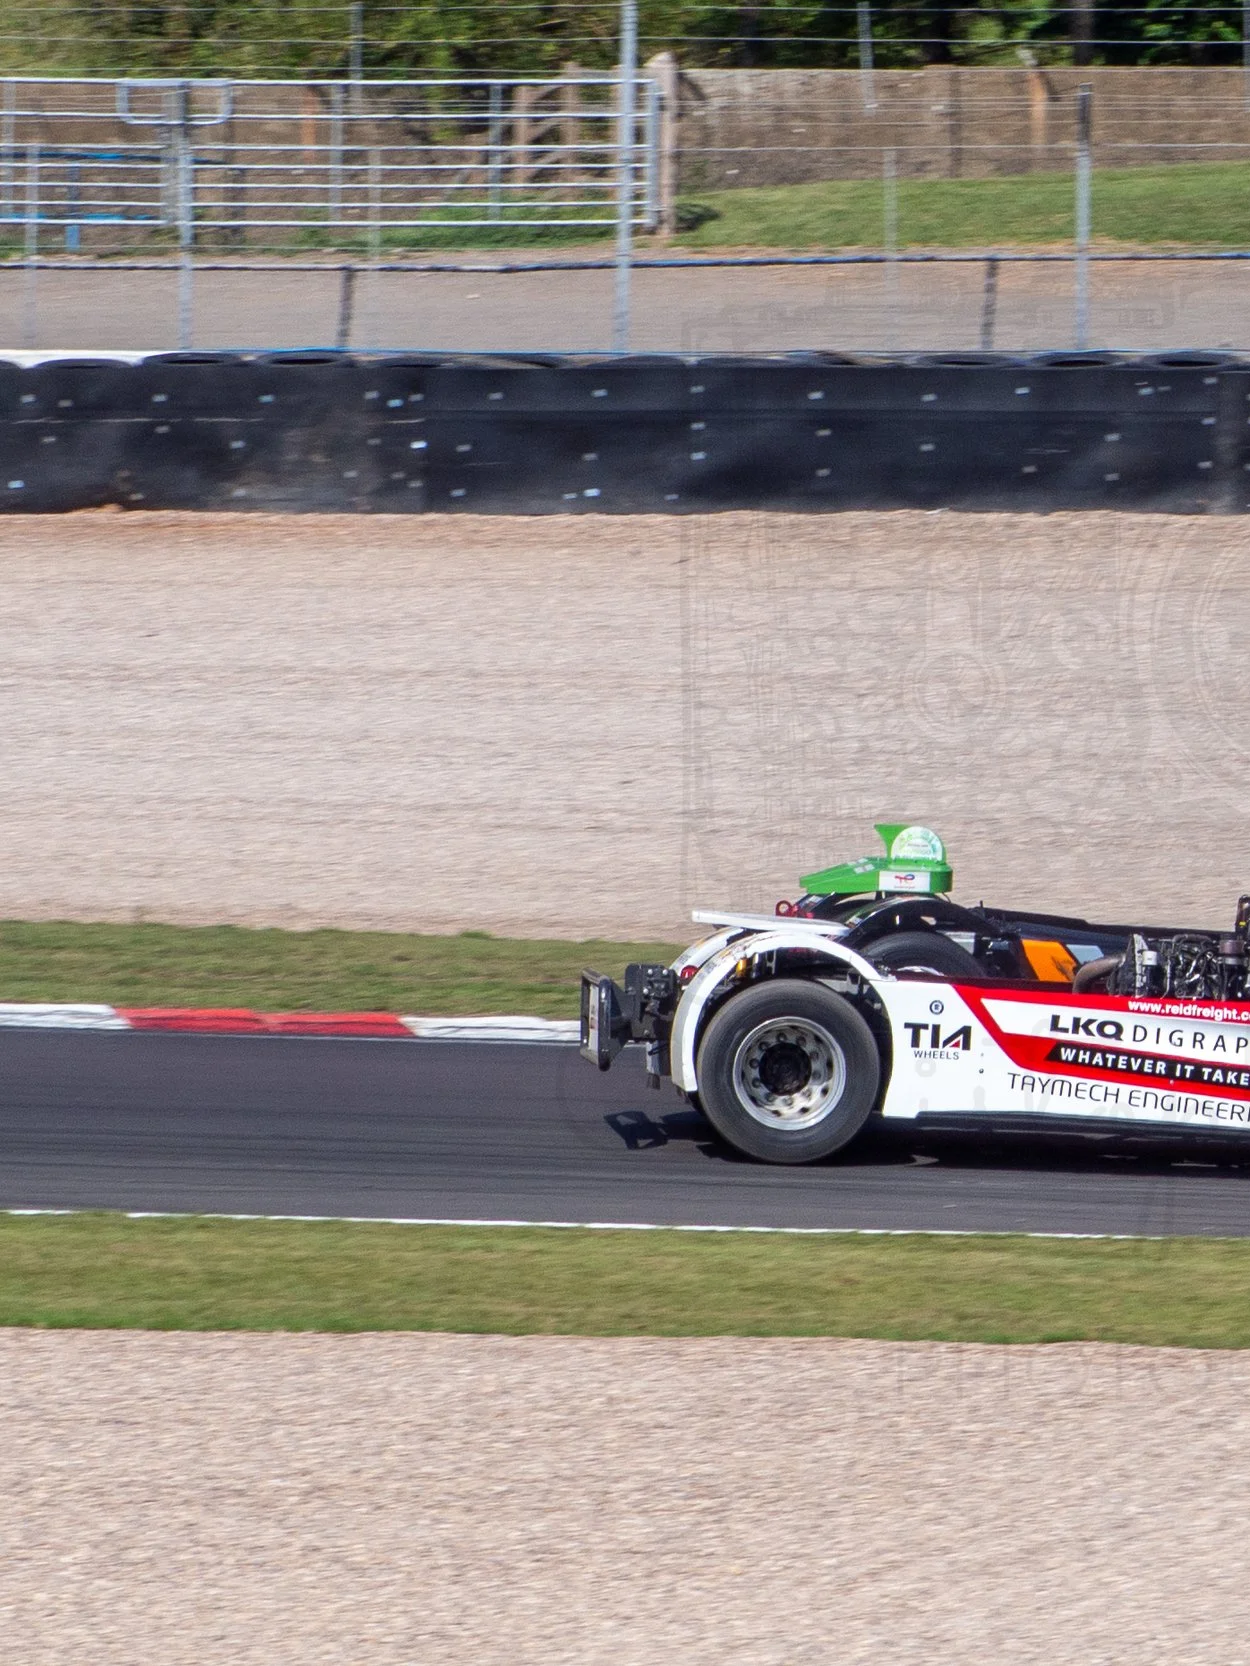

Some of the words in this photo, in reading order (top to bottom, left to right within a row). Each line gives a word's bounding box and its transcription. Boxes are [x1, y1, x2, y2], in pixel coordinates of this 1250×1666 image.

[1050, 1014, 1124, 1041] LKQ
[914, 1050, 960, 1060] WHEELS
[1060, 1047, 1166, 1075] WHATEVER
[1175, 1065, 1195, 1079] IT
[1007, 1072, 1120, 1104] TAYMECH
